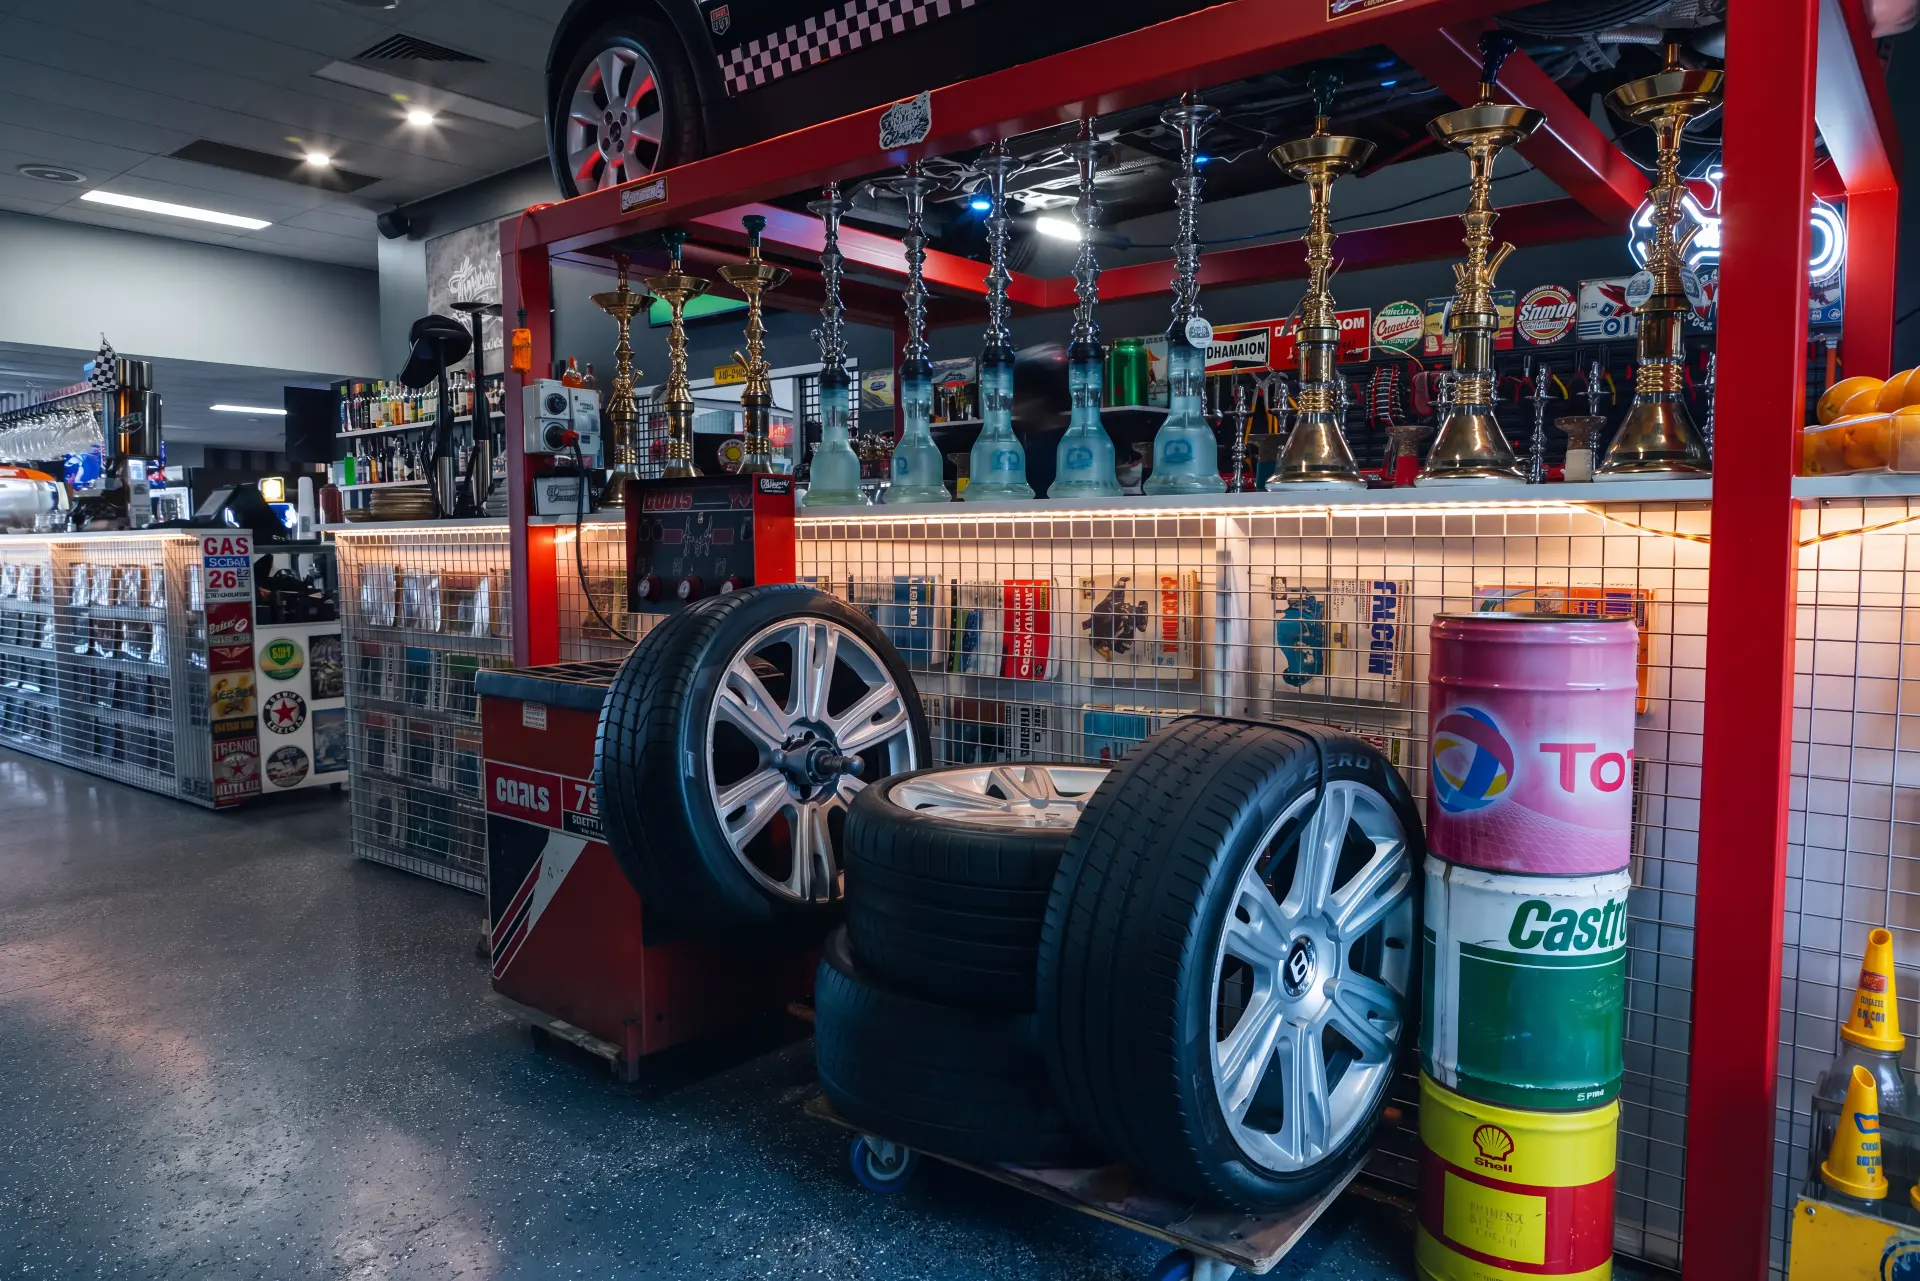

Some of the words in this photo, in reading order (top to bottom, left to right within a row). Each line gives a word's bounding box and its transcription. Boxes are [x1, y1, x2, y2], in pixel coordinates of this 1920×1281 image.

[203, 537, 249, 556] GAS
[208, 569, 237, 589] 26
[1473, 1156, 1513, 1173] Shell
